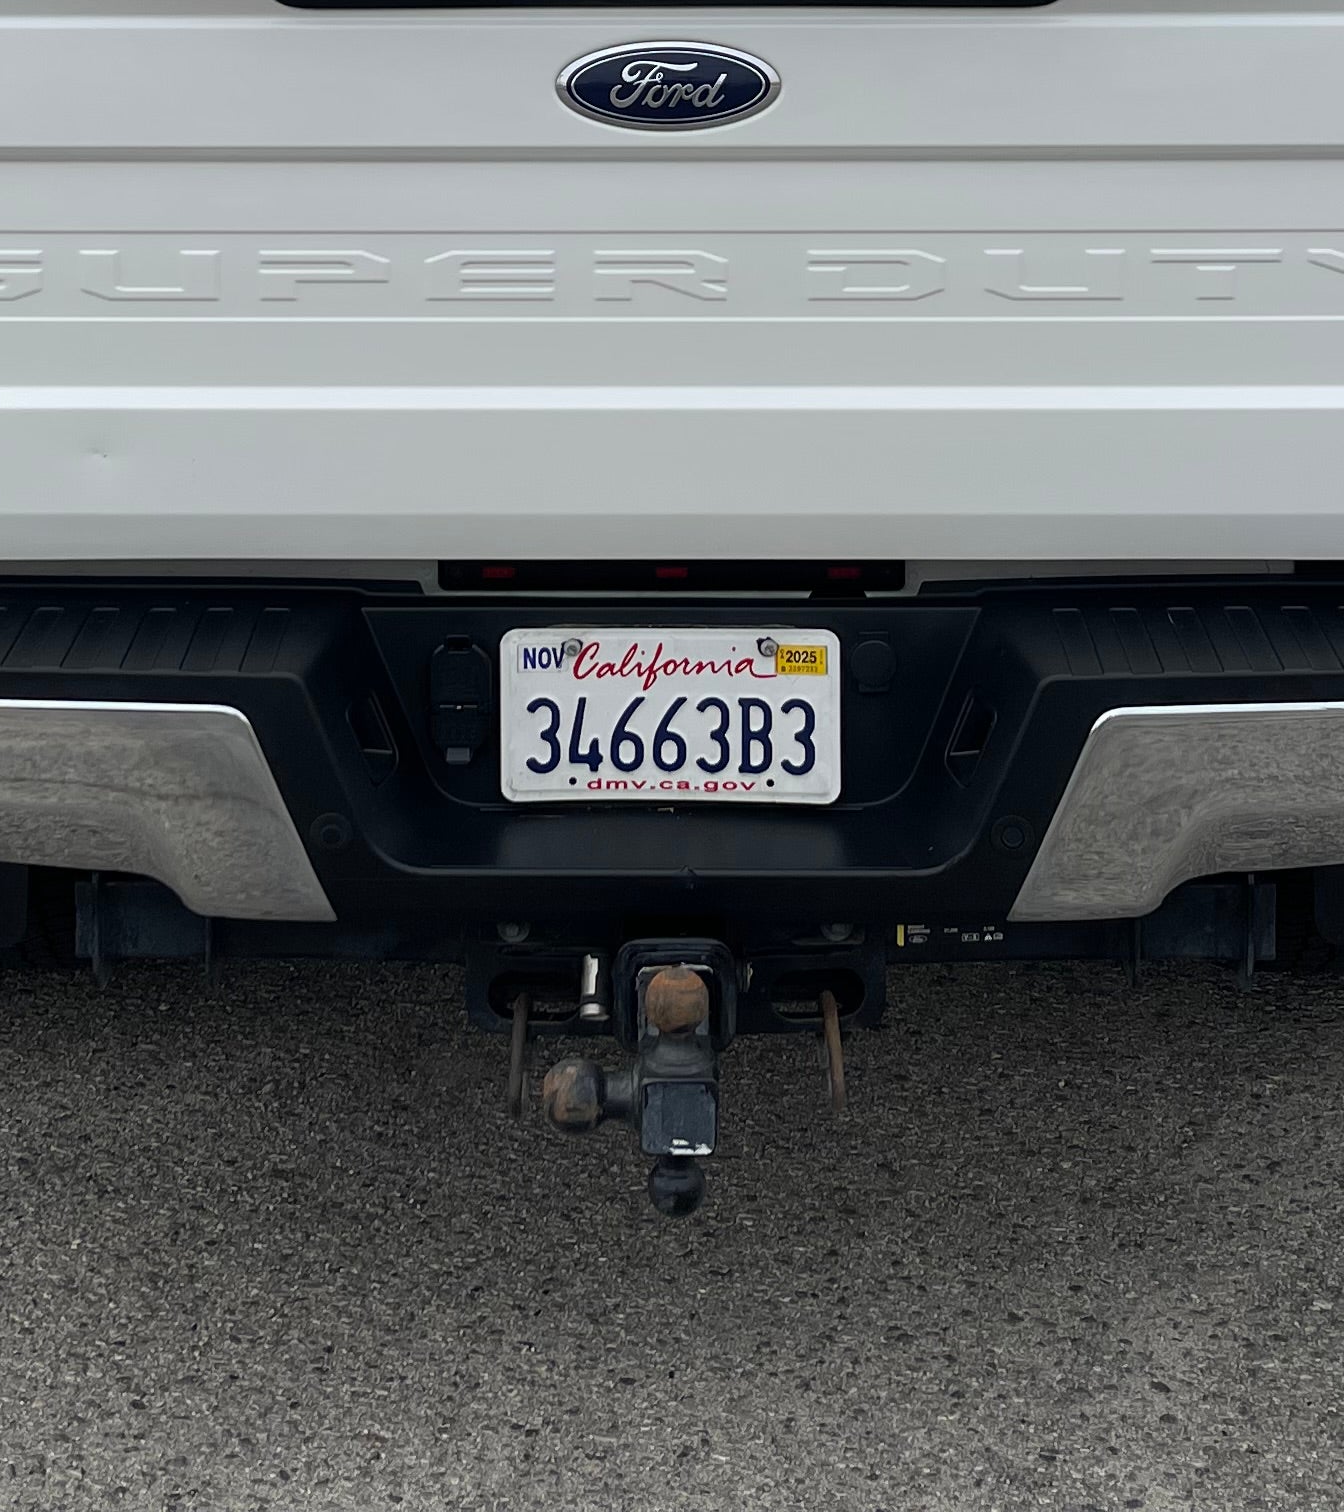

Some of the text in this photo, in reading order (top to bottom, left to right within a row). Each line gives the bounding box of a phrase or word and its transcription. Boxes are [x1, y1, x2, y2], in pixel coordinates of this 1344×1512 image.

[609, 60, 728, 109] Ford
[523, 646, 565, 670] NOV
[572, 641, 778, 691] California
[785, 649, 817, 664] 2025
[525, 696, 817, 776] 34663B3
[587, 777, 757, 793] dmv.ca.gov
